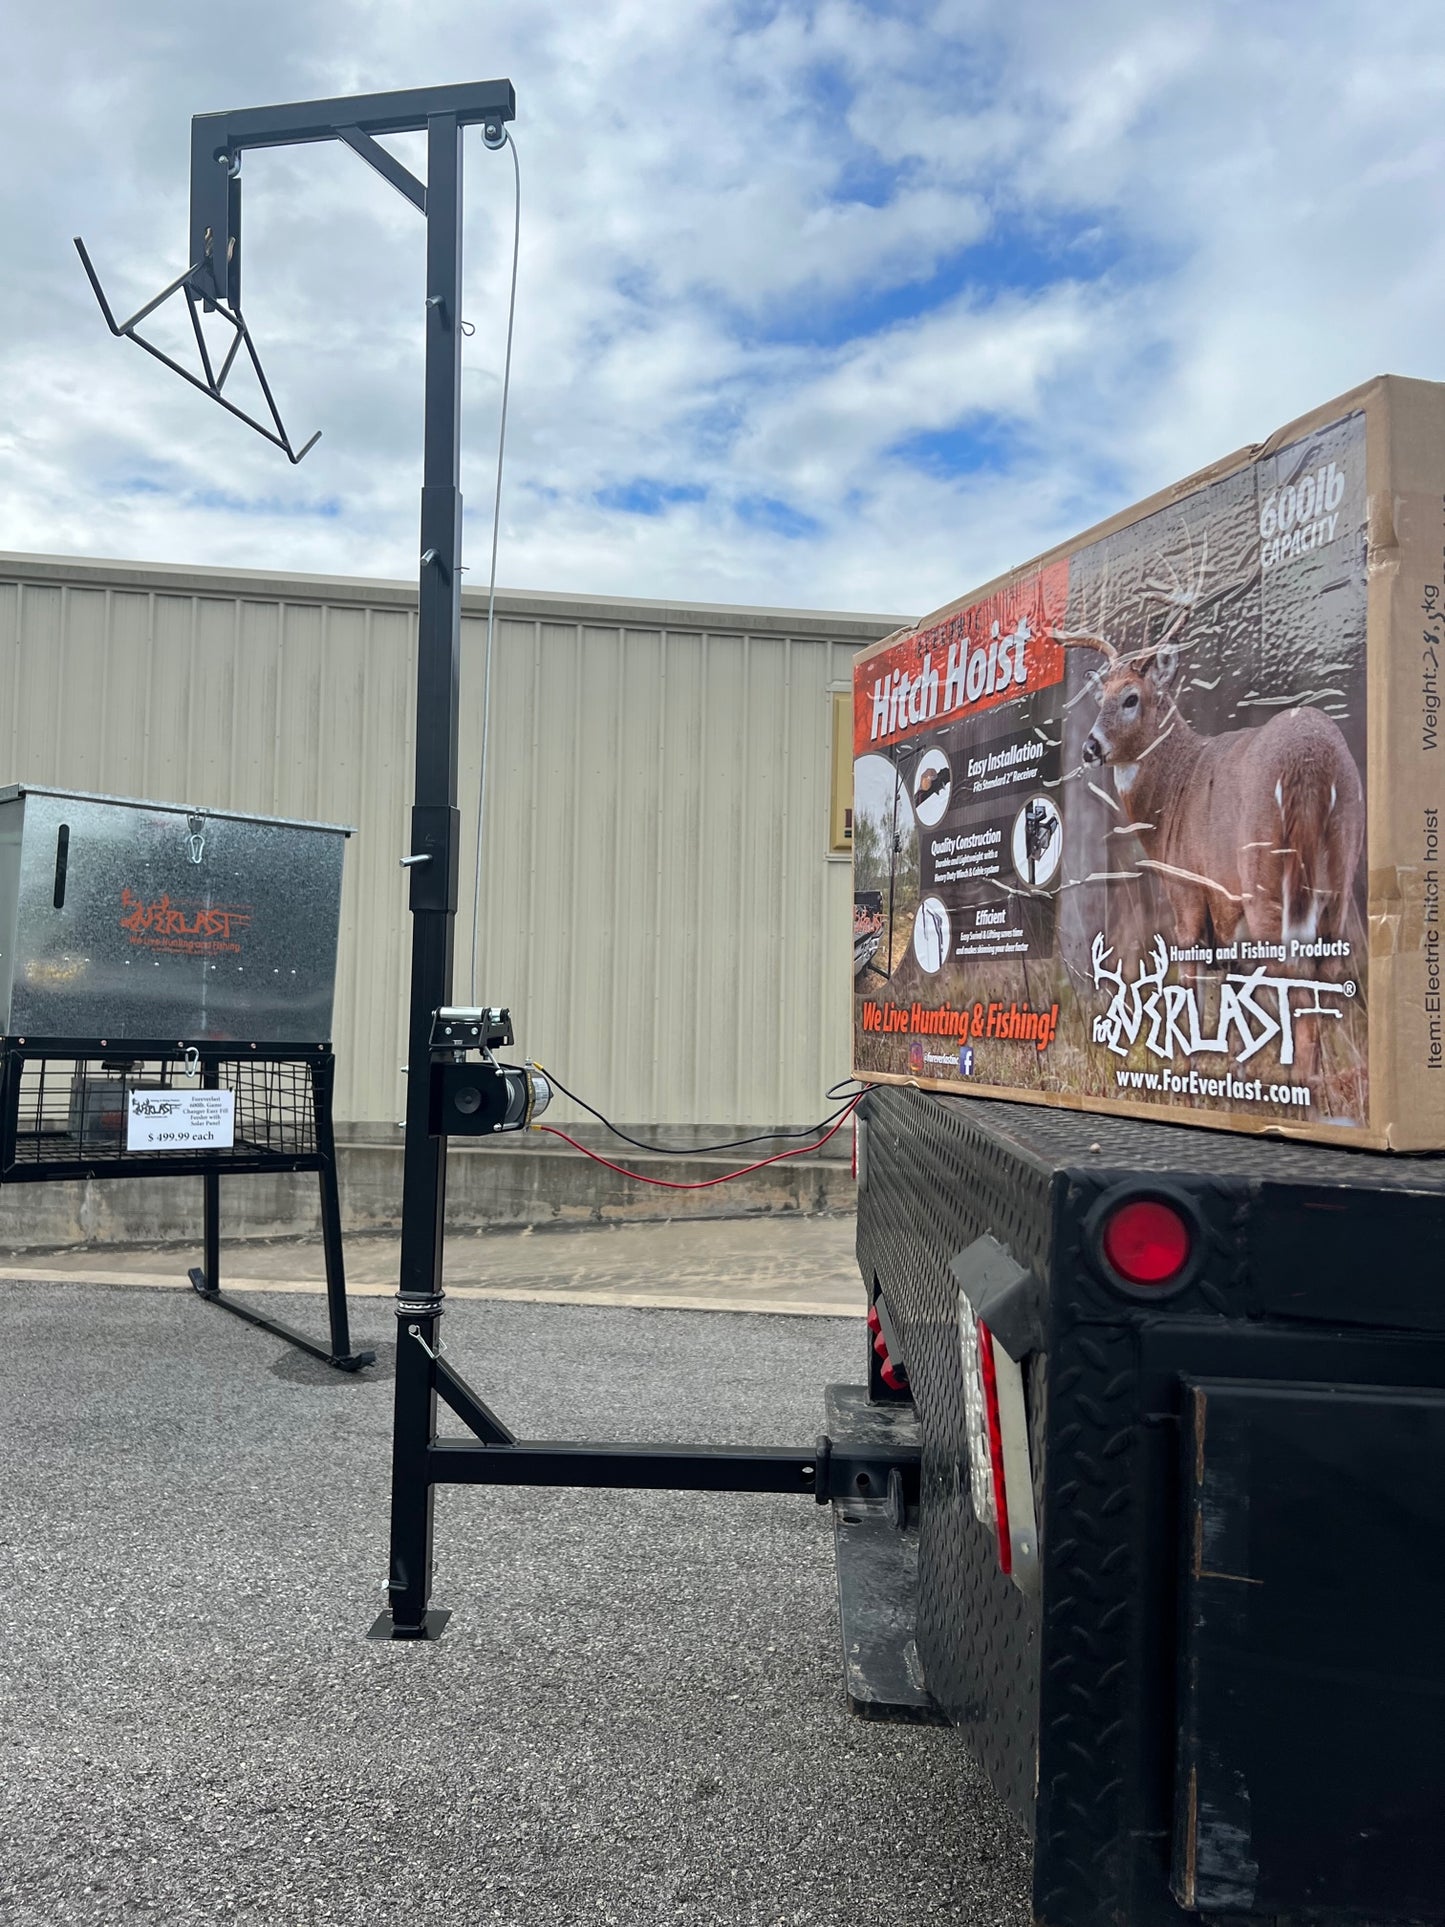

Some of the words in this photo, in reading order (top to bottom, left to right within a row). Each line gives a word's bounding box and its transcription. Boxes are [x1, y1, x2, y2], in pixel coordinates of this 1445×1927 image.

[1260, 461, 1345, 539] 600lb
[1261, 511, 1339, 568] CAPACITY
[870, 653, 939, 741] Hitch
[943, 615, 1031, 712] Hoist
[967, 758, 988, 778] Easy
[987, 740, 1044, 772] Installation
[973, 780, 982, 793] Fits
[982, 773, 1006, 790] Standard
[1012, 767, 1038, 782] Receiver
[931, 836, 956, 856] Quality
[956, 828, 1002, 851] Construction
[1423, 808, 1438, 862] hoist
[1424, 868, 1439, 923] hitch
[975, 908, 1006, 926] Efficient
[1170, 945, 1213, 964] Hunting
[1215, 946, 1238, 960] and
[1241, 940, 1286, 962] Fishing
[1290, 937, 1350, 958] Products
[863, 1002, 882, 1032] We
[882, 1002, 909, 1033] Live
[910, 1002, 970, 1046] Hunting
[970, 1002, 985, 1038] &
[986, 1002, 1059, 1051] Fishing!
[1116, 1069, 1311, 1106] www.ForEverlast.com
[156, 1132, 190, 1142] 499.99
[192, 1131, 214, 1141] each
